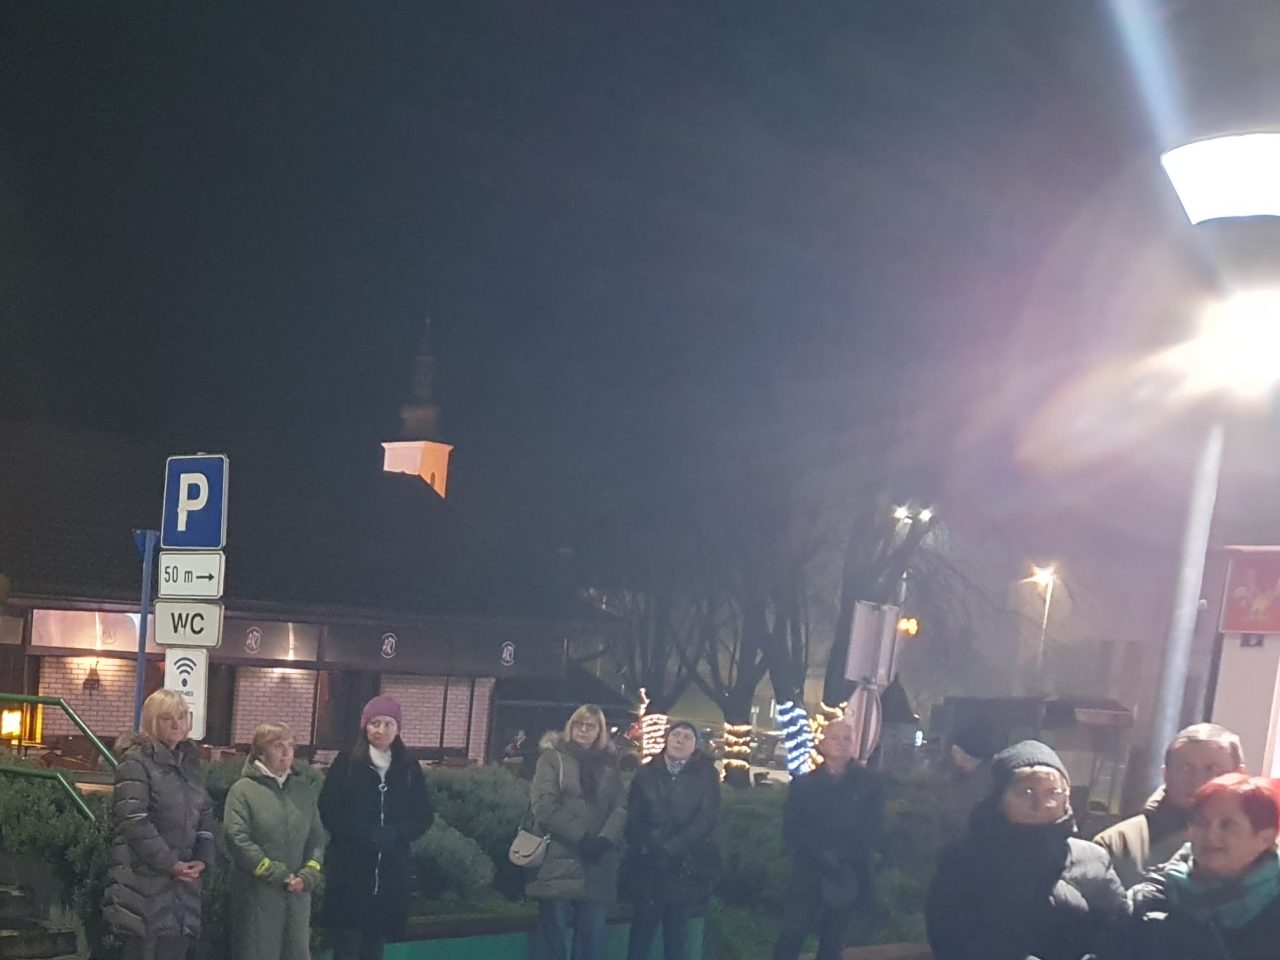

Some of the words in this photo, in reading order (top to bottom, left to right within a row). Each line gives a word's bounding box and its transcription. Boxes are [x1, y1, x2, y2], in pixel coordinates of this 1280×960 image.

[177, 472, 209, 532] P
[164, 565, 179, 584] 50
[184, 569, 193, 584] m
[171, 612, 205, 635] WC
